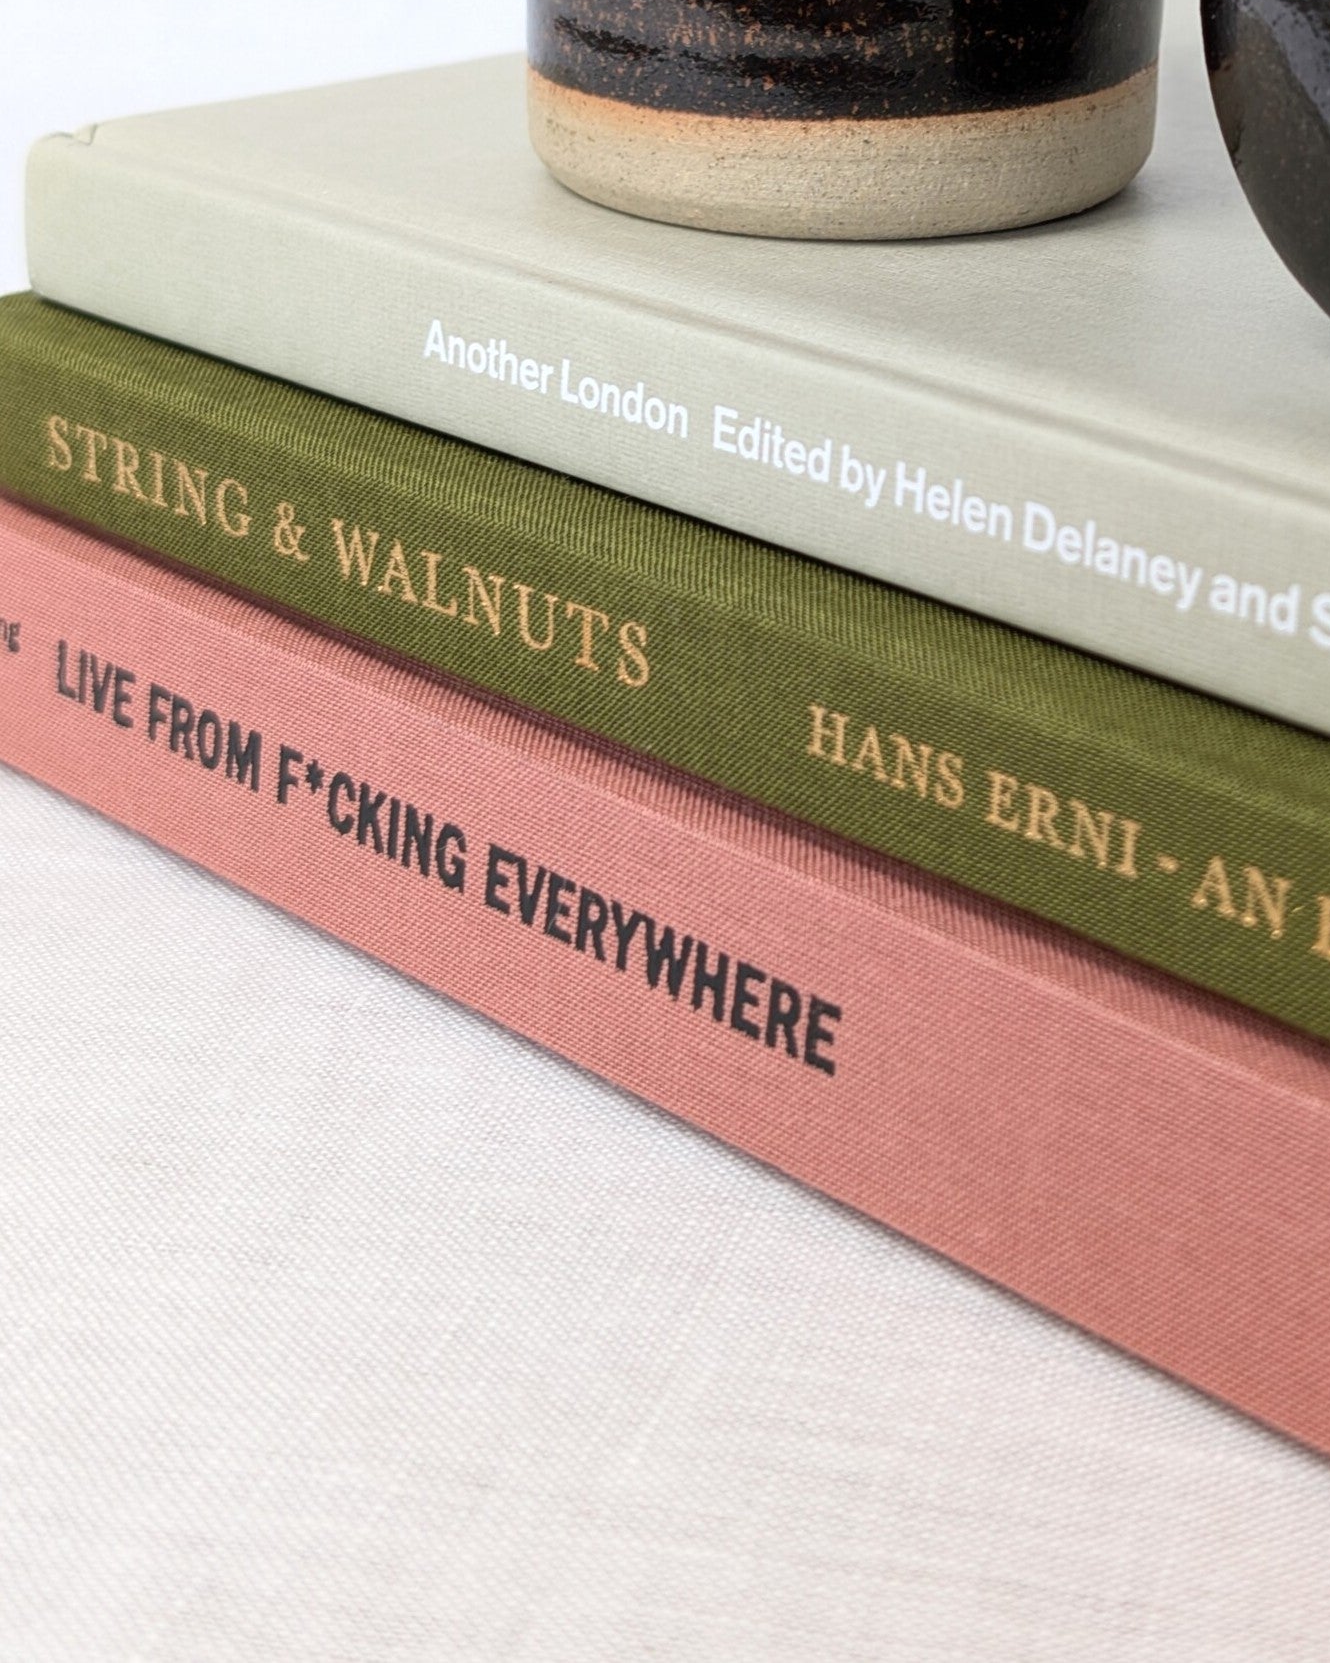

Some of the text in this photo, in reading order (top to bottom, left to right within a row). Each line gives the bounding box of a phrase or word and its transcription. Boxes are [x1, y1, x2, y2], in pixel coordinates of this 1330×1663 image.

[47, 414, 253, 538] STRING
[273, 500, 309, 561] &
[329, 518, 651, 687] WALNUTS
[807, 704, 966, 809] HANS
[984, 770, 1143, 879] ERNI
[1191, 855, 1293, 939] AN
[422, 319, 554, 395] Another
[560, 358, 689, 439] London
[712, 404, 832, 485] Edited
[840, 445, 887, 509] by
[894, 460, 1013, 542] Helen
[1022, 500, 1203, 612] Delaney
[1208, 572, 1300, 636] and
[56, 638, 134, 729] LIVE
[148, 682, 263, 793] FROM
[484, 842, 843, 1077] EVERYWHERE
